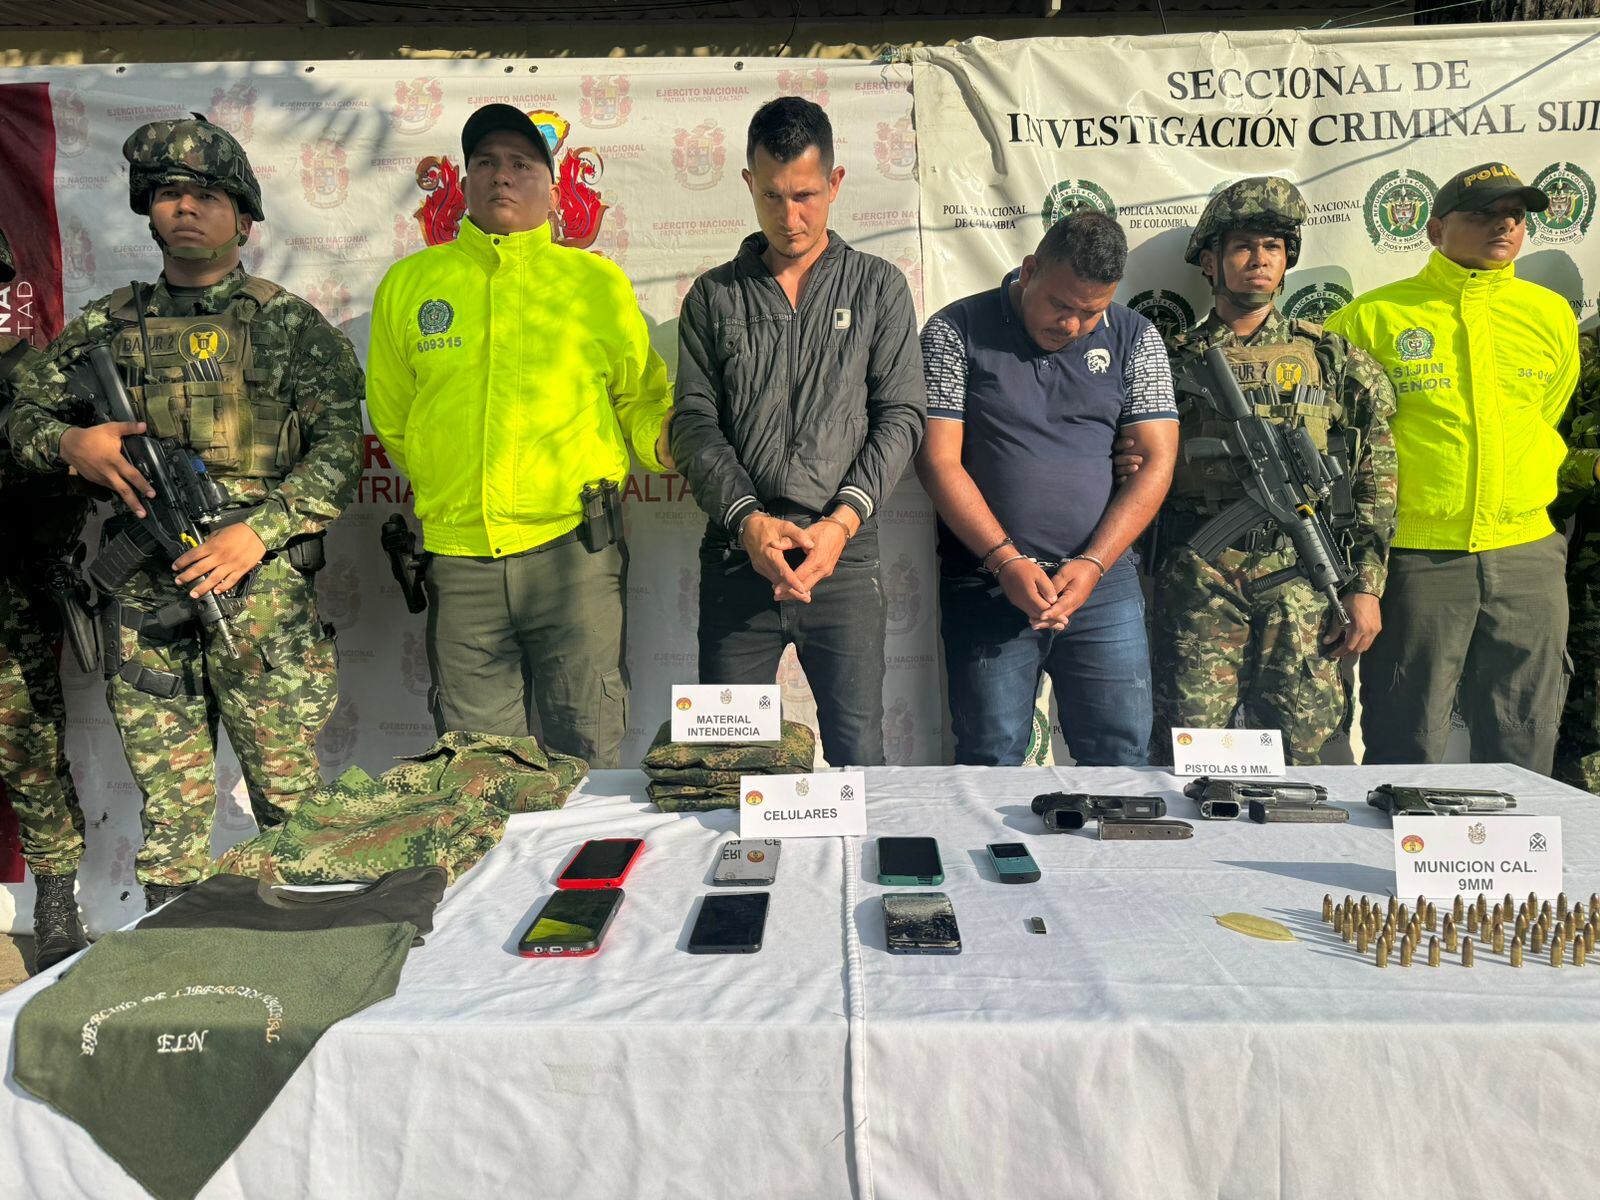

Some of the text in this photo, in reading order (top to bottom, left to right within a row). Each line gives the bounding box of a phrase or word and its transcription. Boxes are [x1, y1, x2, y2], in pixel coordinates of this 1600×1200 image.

[1168, 59, 1471, 100] SECCIONAL DE
[703, 86, 750, 96] NACIONAL
[512, 93, 558, 103] NACIONAL
[1007, 100, 1600, 149] INVESTIGACIÓN CRIMINAL SIJI
[600, 144, 646, 153] NACIONAL
[943, 204, 978, 216] POLICA
[1120, 205, 1199, 216] POLICIA NACIONAL
[1313, 200, 1361, 213] NACIONAL
[699, 219, 746, 228] NACIONAL
[955, 218, 968, 228] DE
[1130, 219, 1189, 228] DE COLOMBIA
[326, 235, 368, 244] NACIONAL
[417, 336, 462, 353] 609315
[1393, 363, 1444, 378] SIJIN
[696, 715, 751, 725] MATERIAL
[687, 726, 760, 737] INTENDENCIA
[1185, 764, 1272, 775] PISTOLAS 9 MM.
[763, 808, 838, 821] CELULARES
[1414, 860, 1537, 873] MUNICION CAL.
[1458, 878, 1493, 891] 9MM
[157, 1030, 209, 1055] ELN
